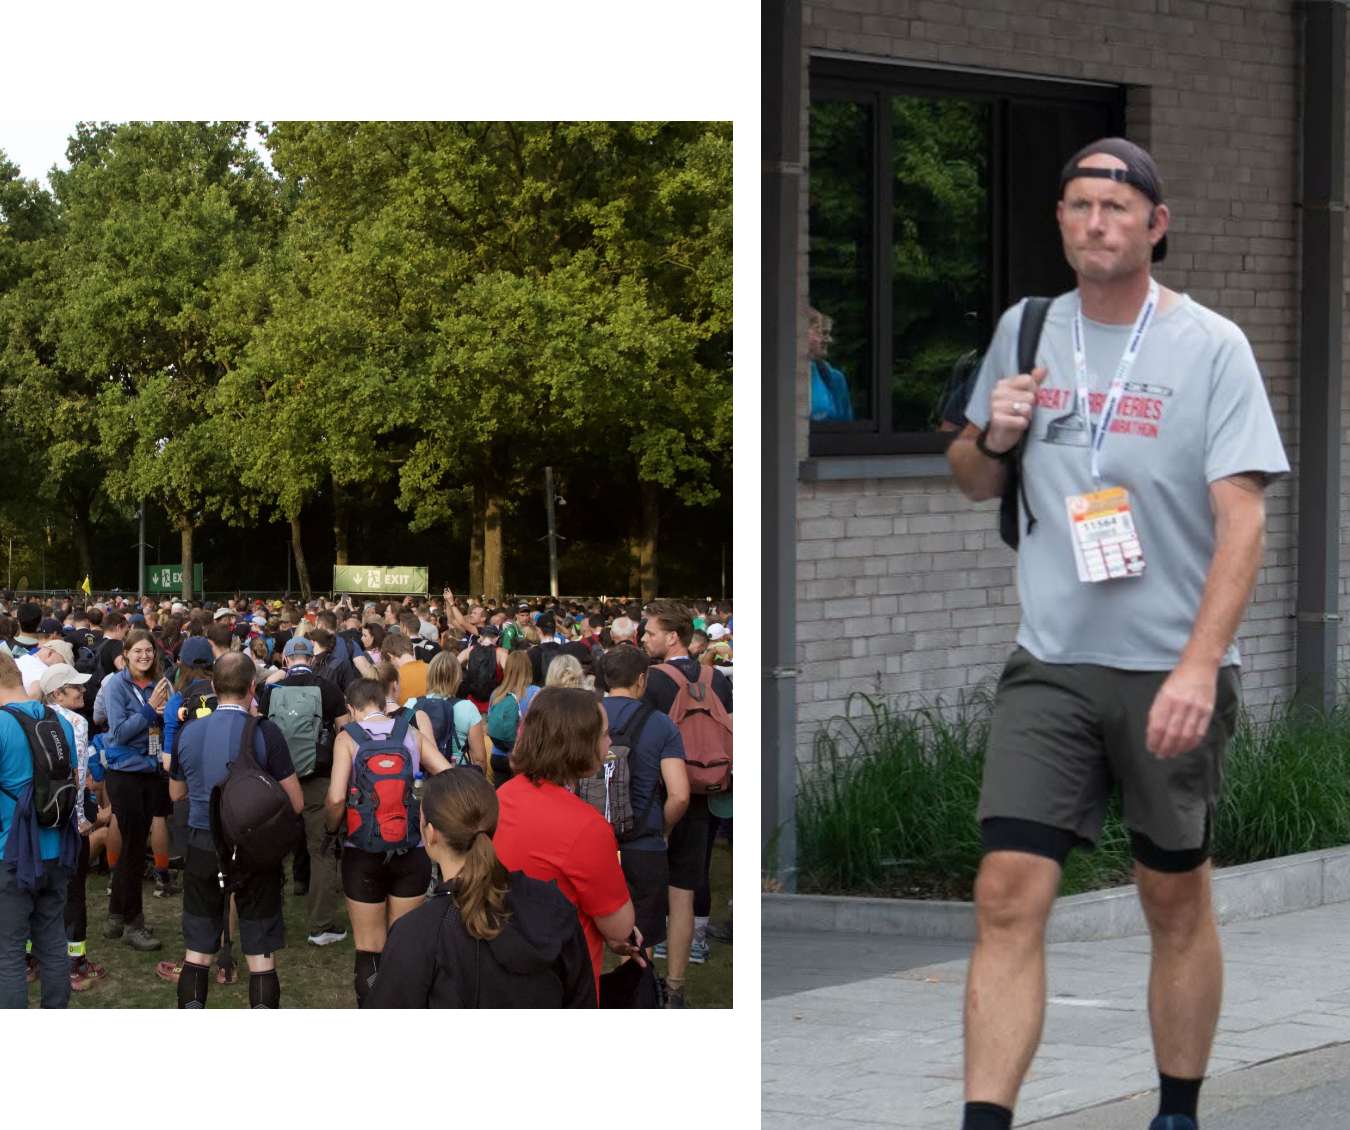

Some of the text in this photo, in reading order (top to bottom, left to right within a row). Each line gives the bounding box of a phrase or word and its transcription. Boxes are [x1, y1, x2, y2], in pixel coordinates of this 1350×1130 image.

[1036, 387, 1164, 420] REAT BRERIES
[384, 574, 411, 585] EXIT
